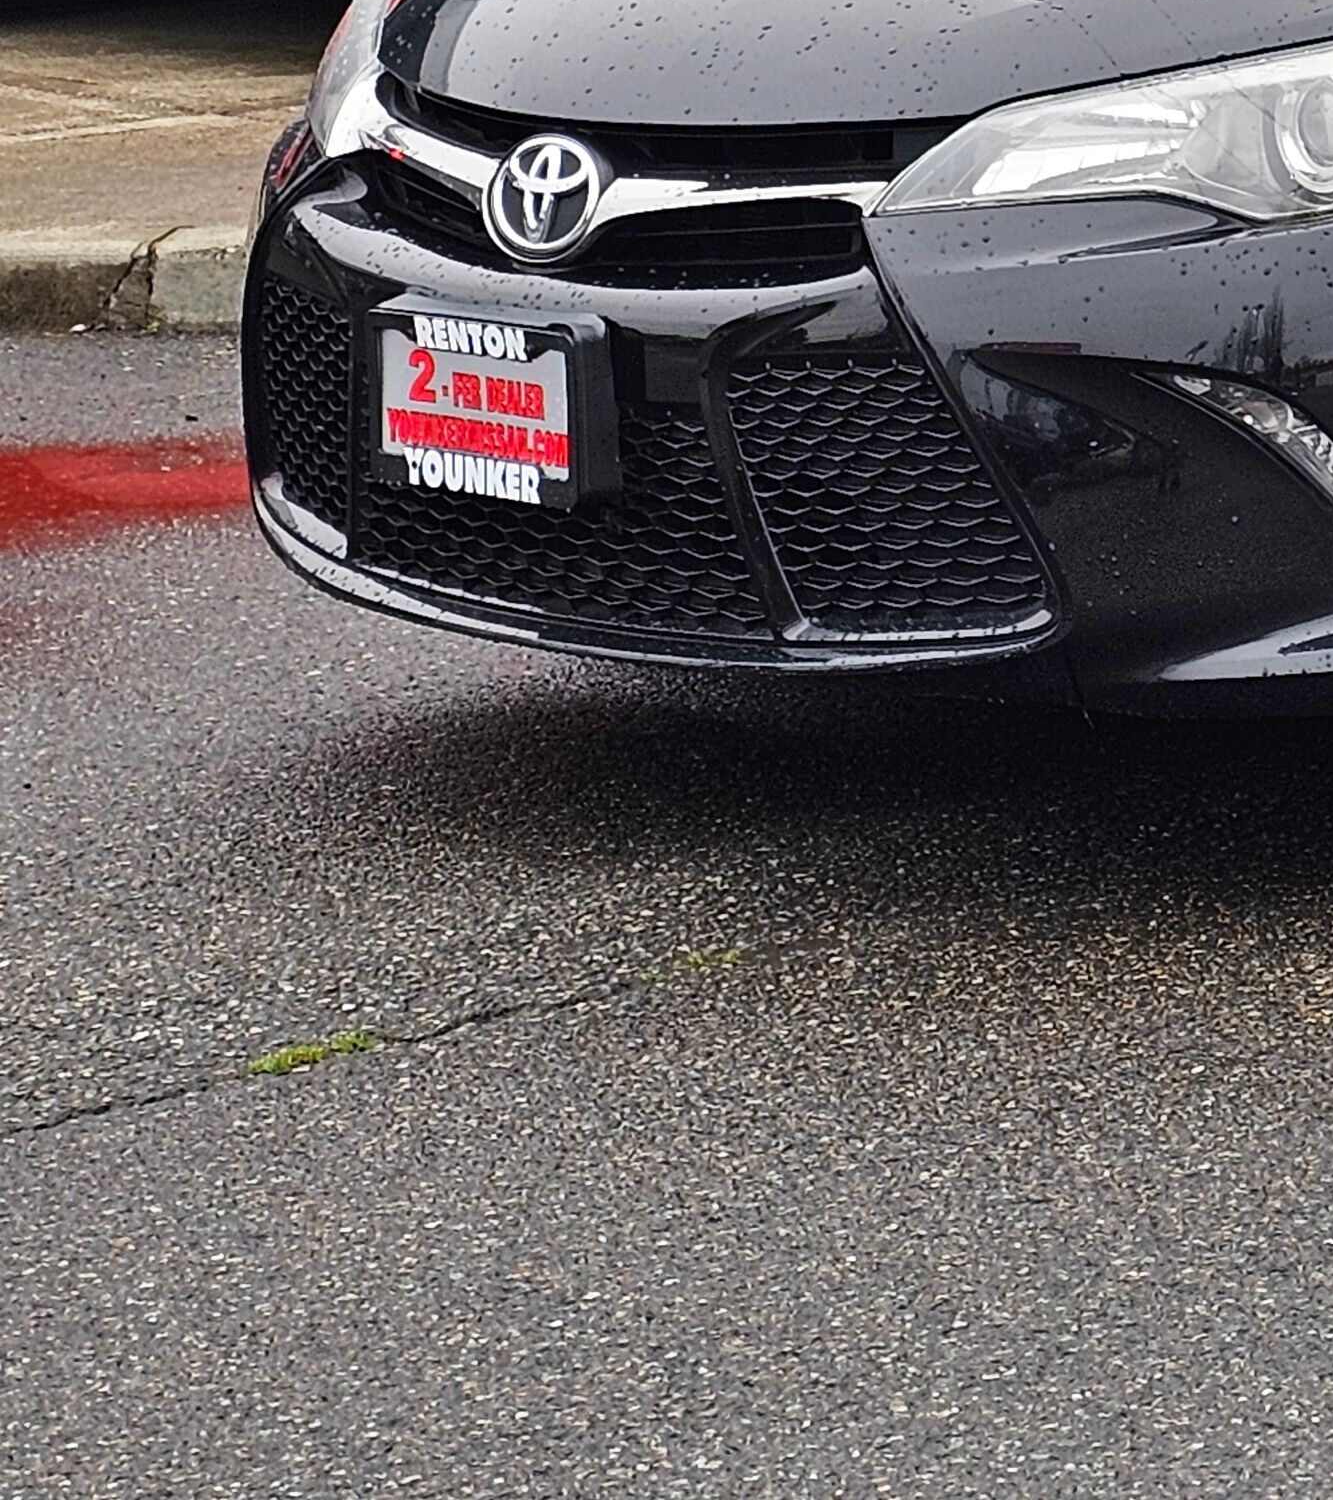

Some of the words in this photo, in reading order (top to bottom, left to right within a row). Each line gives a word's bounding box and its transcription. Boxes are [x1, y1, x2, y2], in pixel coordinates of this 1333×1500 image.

[412, 315, 528, 362] RENTON
[408, 349, 437, 404] 2
[452, 371, 482, 411] PER
[486, 376, 546, 421] DEALER
[403, 445, 542, 505] YOUNKER
